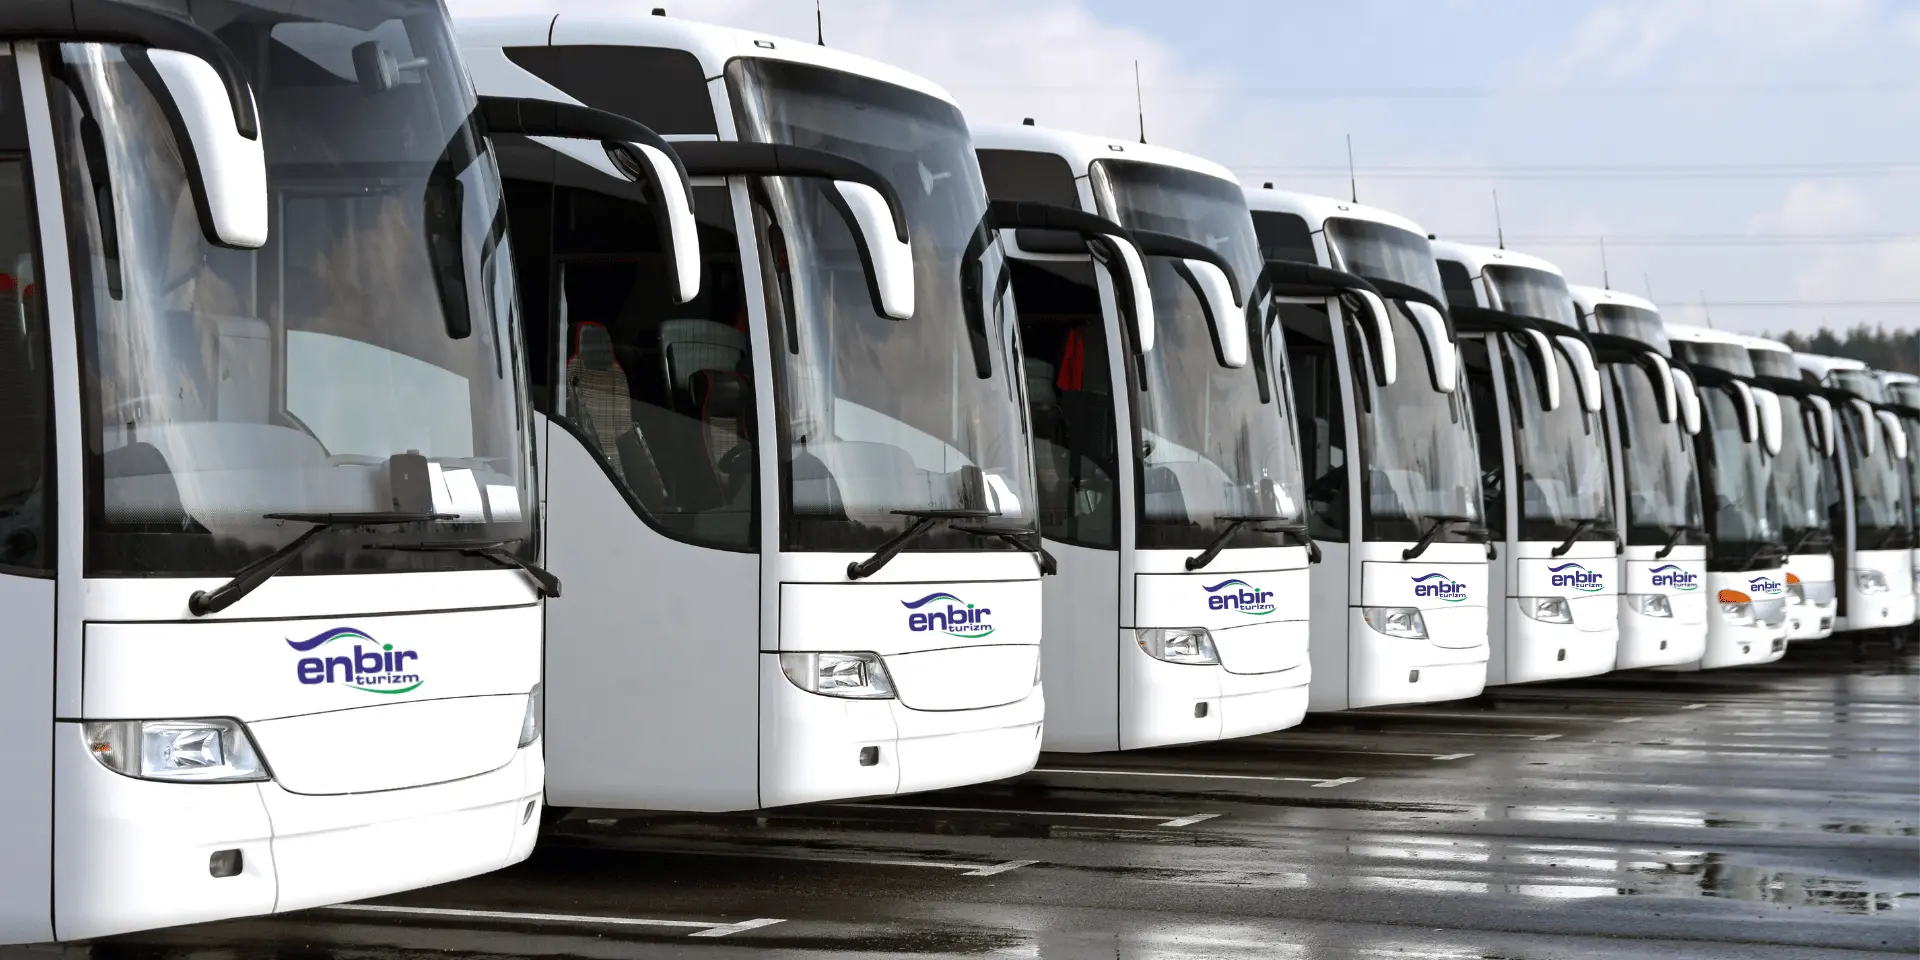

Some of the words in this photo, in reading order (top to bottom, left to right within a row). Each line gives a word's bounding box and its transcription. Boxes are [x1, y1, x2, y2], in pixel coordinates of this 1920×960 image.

[1552, 571, 1602, 586] enbir
[1652, 571, 1697, 586] enbir
[1751, 581, 1781, 591] enbir
[1415, 581, 1466, 596] enbir
[1208, 588, 1274, 610] enbir
[909, 604, 991, 631] enbir
[948, 623, 992, 632] turizm
[297, 643, 418, 685] enbir
[355, 673, 420, 685] turizm
